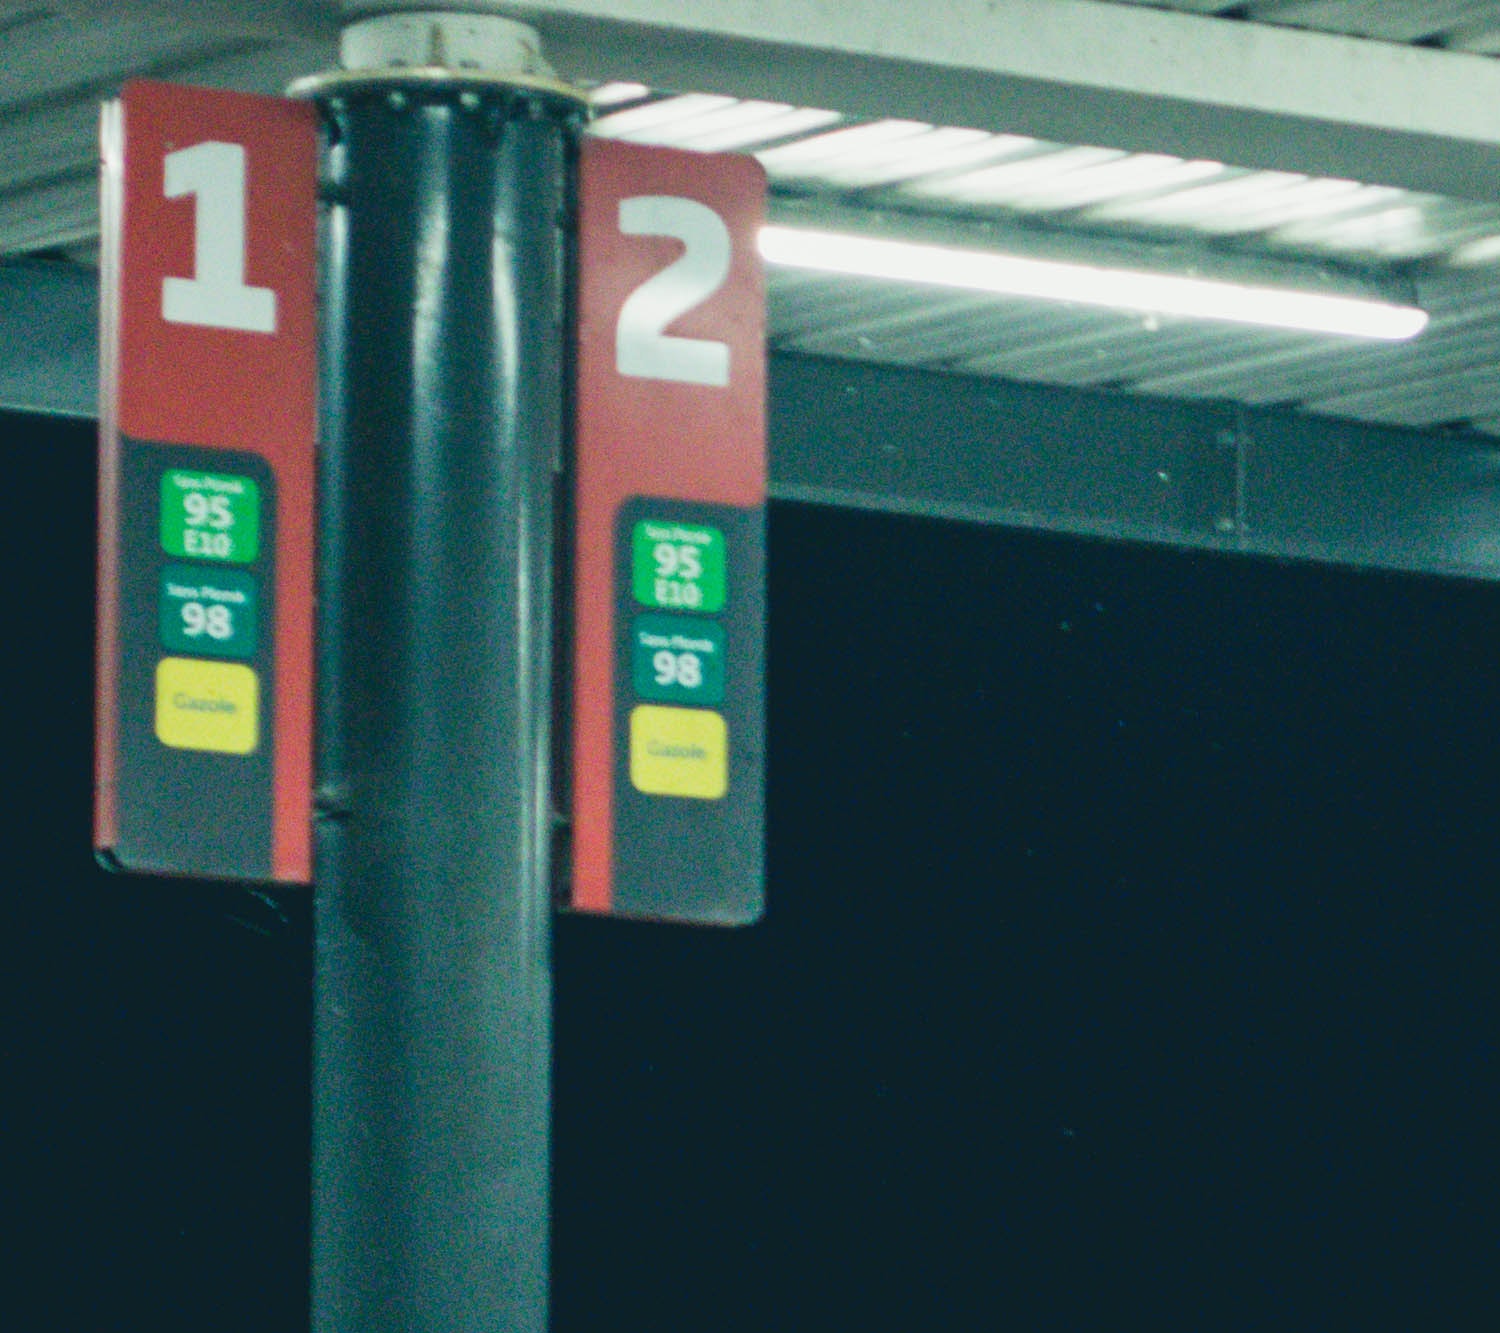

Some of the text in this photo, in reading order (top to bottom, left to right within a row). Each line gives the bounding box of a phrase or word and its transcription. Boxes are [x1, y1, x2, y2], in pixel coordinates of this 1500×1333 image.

[160, 139, 277, 334] 1
[615, 194, 732, 387] 2
[182, 492, 235, 530] 95
[653, 543, 702, 580] 95
[181, 602, 235, 641] 98
[652, 651, 703, 689] 98
